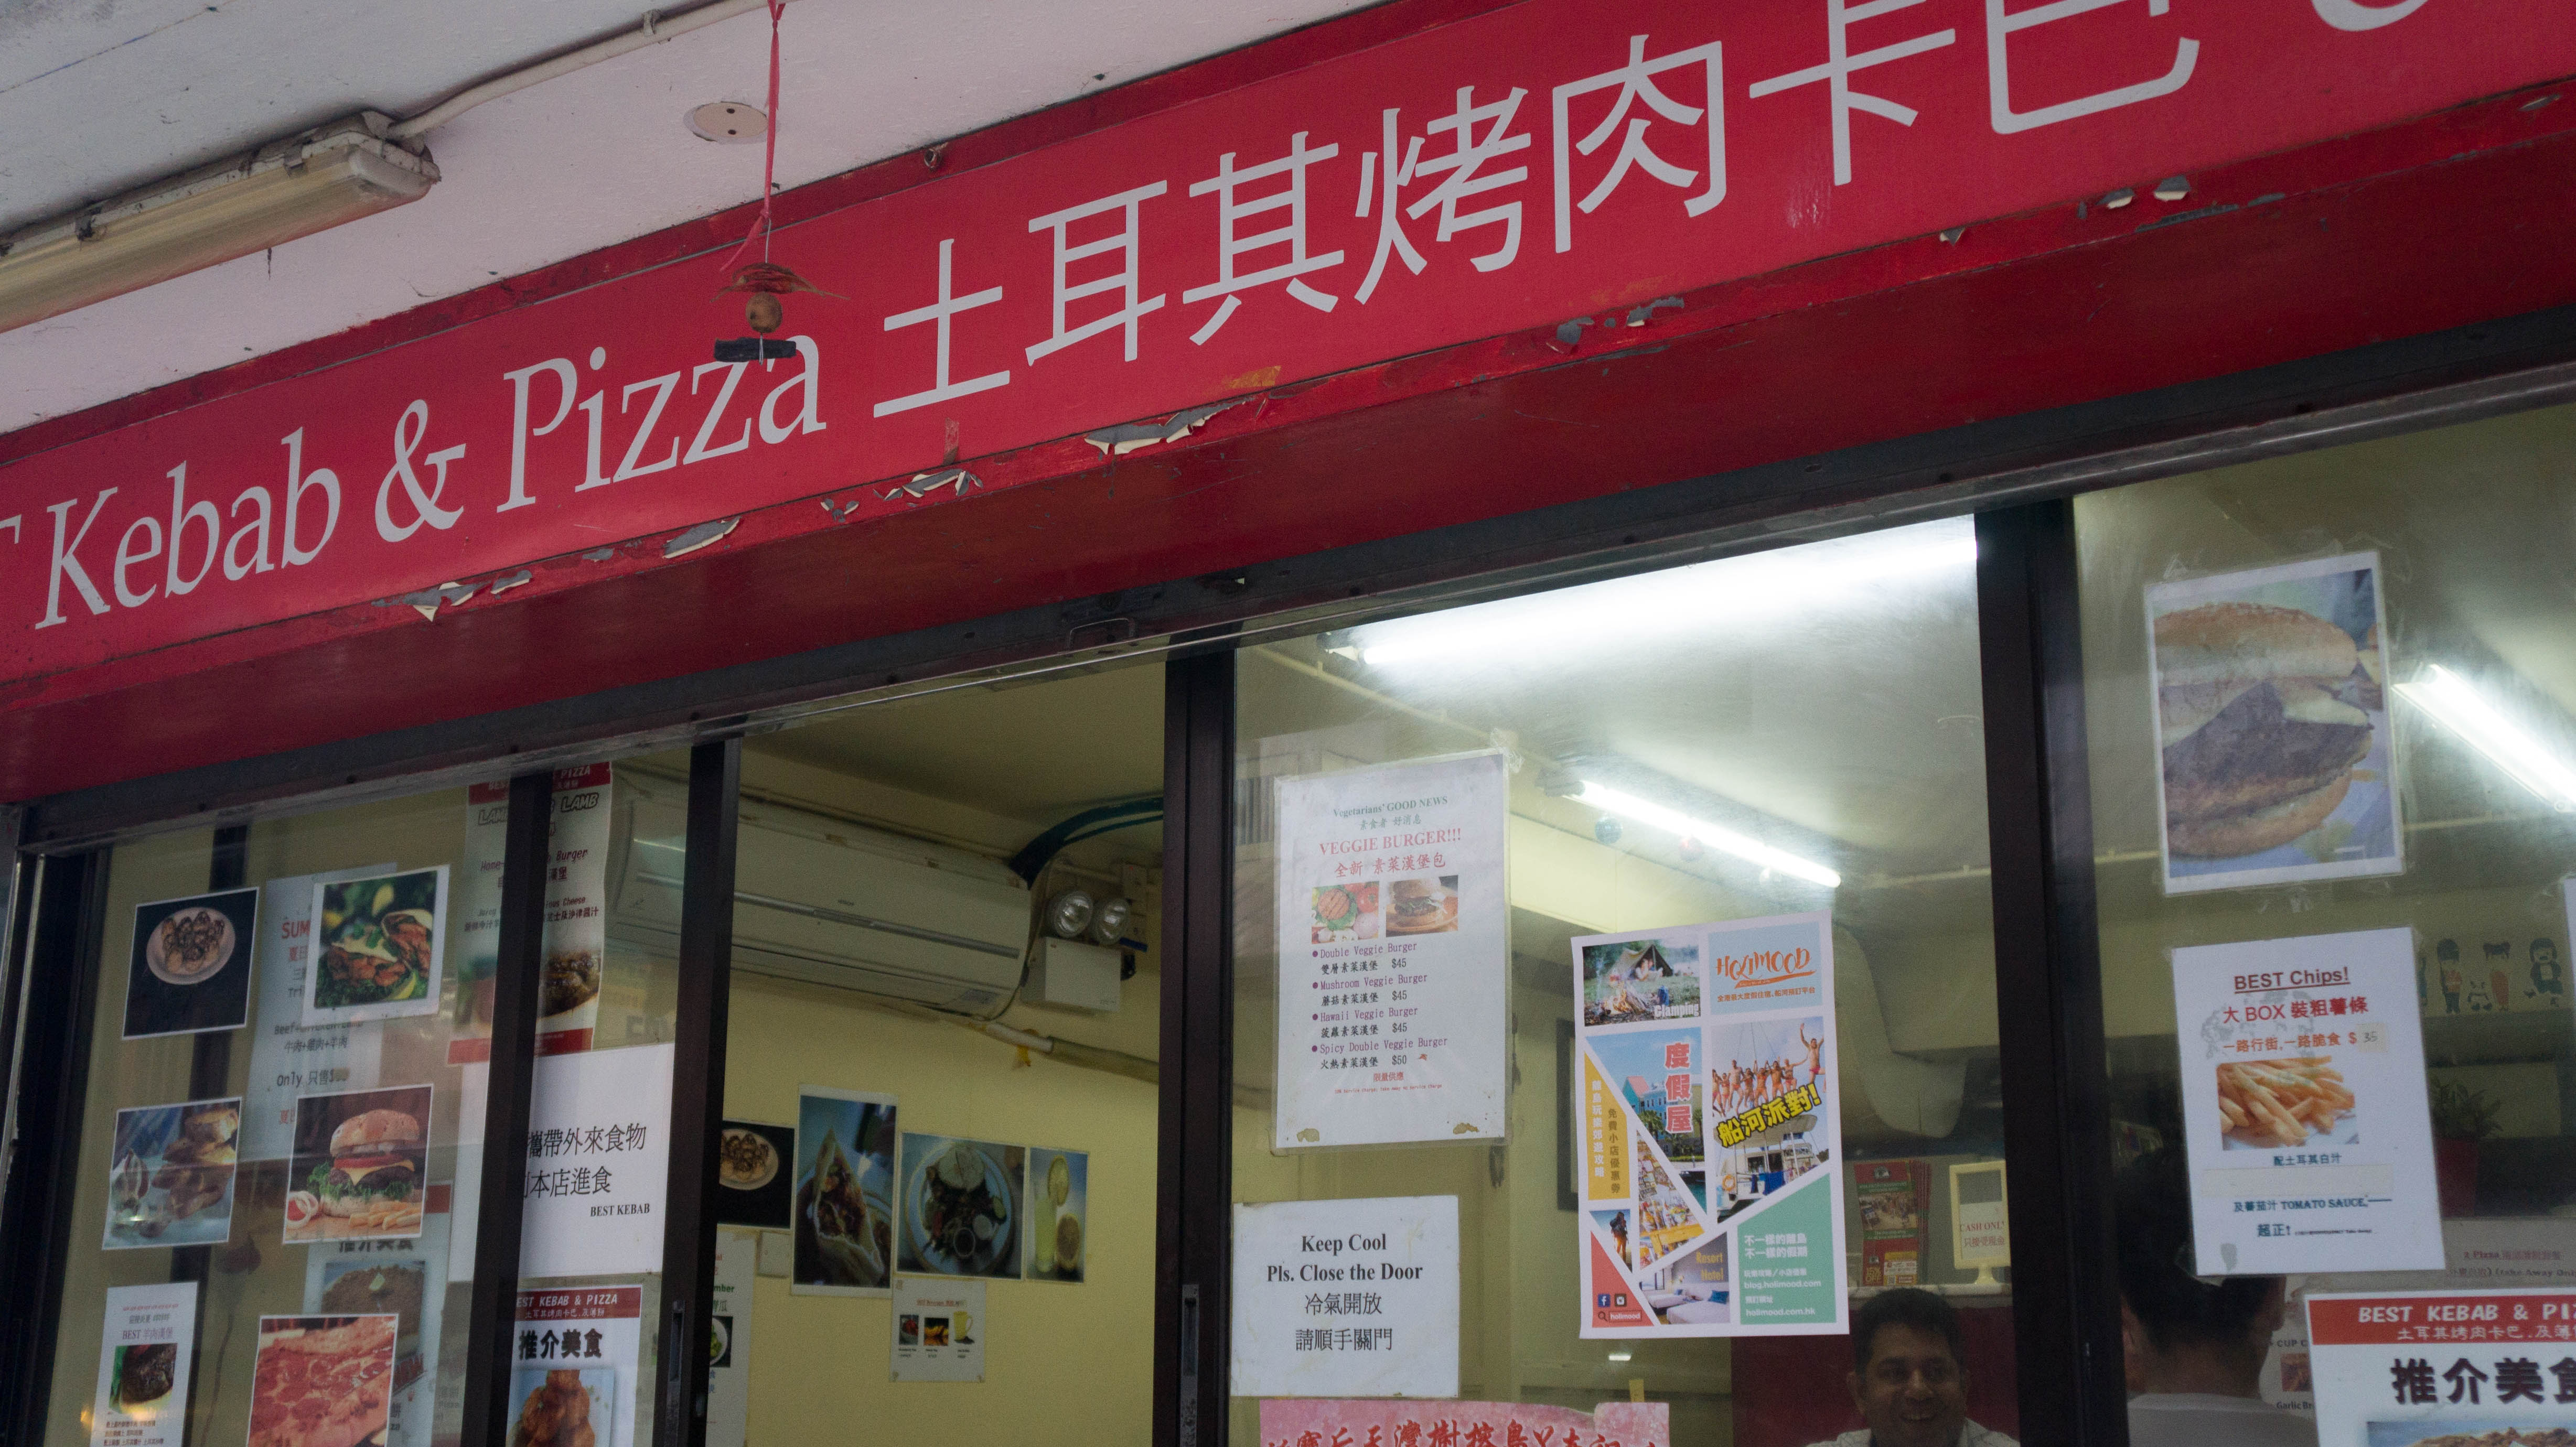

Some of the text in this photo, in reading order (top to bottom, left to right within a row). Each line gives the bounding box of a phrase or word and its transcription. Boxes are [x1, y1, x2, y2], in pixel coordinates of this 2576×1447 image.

[35, 0, 2199, 630] Kebab & Pizza 土耳其烤肉卡巴
[478, 792, 599, 826] LAM LAMB
[1387, 800, 1416, 812] GOOD
[1419, 796, 1447, 808] NEWS
[1360, 818, 1388, 830] 素食者
[1319, 828, 1461, 856] VEGGIE BURGER!!!
[556, 849, 588, 863] Burger
[1334, 852, 1446, 878] 全新 素菜漢堡包
[563, 896, 586, 906] Cheese
[282, 920, 310, 940] SUM
[1321, 943, 1417, 959] Double Veggie Burger
[1391, 958, 1407, 969] $45
[1715, 947, 1811, 980] HOLIMOOD
[1321, 974, 1427, 990] Mushroom Veggie Burger
[2234, 966, 2349, 990] BEST Chips!
[1392, 990, 1408, 1001] $45
[1321, 1006, 1418, 1022] Hawaii Veggie Burger
[1654, 1002, 1699, 1018] Glamping
[2224, 996, 2368, 1023] 大 BOX 裝粗薯條
[1392, 1022, 1408, 1033] $45
[2348, 1031, 2357, 1044] $
[1321, 1037, 1448, 1055] Spicy Double Veggie Burger
[1391, 1054, 1407, 1066] $50
[277, 1071, 302, 1088] Only
[1373, 1072, 1404, 1082] 限量供應
[1665, 1042, 1692, 1133] 度假屋
[1716, 1082, 1821, 1148] 船河派對!
[2273, 1153, 2342, 1166] 配土耳其白汁
[524, 1165, 613, 1198] 本店進食
[591, 1203, 650, 1216] BEST KEBAB
[2281, 1199, 2326, 1210] TOMATO
[1301, 1233, 1387, 1257] Keep Cool
[1267, 1262, 1423, 1282] Pls. Close the Door
[1744, 1280, 1821, 1290] blog.holimood.com
[516, 1293, 618, 1308] EST KEBAB & PIZZA
[1305, 1292, 1382, 1315] 冷氣開放
[1746, 1308, 1815, 1316] holimood.com.hk
[2358, 1305, 2413, 1323] BEST
[2428, 1304, 2498, 1322] KEBAB
[2514, 1303, 2528, 1321] &
[122, 1330, 142, 1341] BEST
[1295, 1328, 1393, 1351] 請順手關門
[518, 1328, 603, 1360] 推介美食
[2276, 1401, 2301, 1410] Garlic
